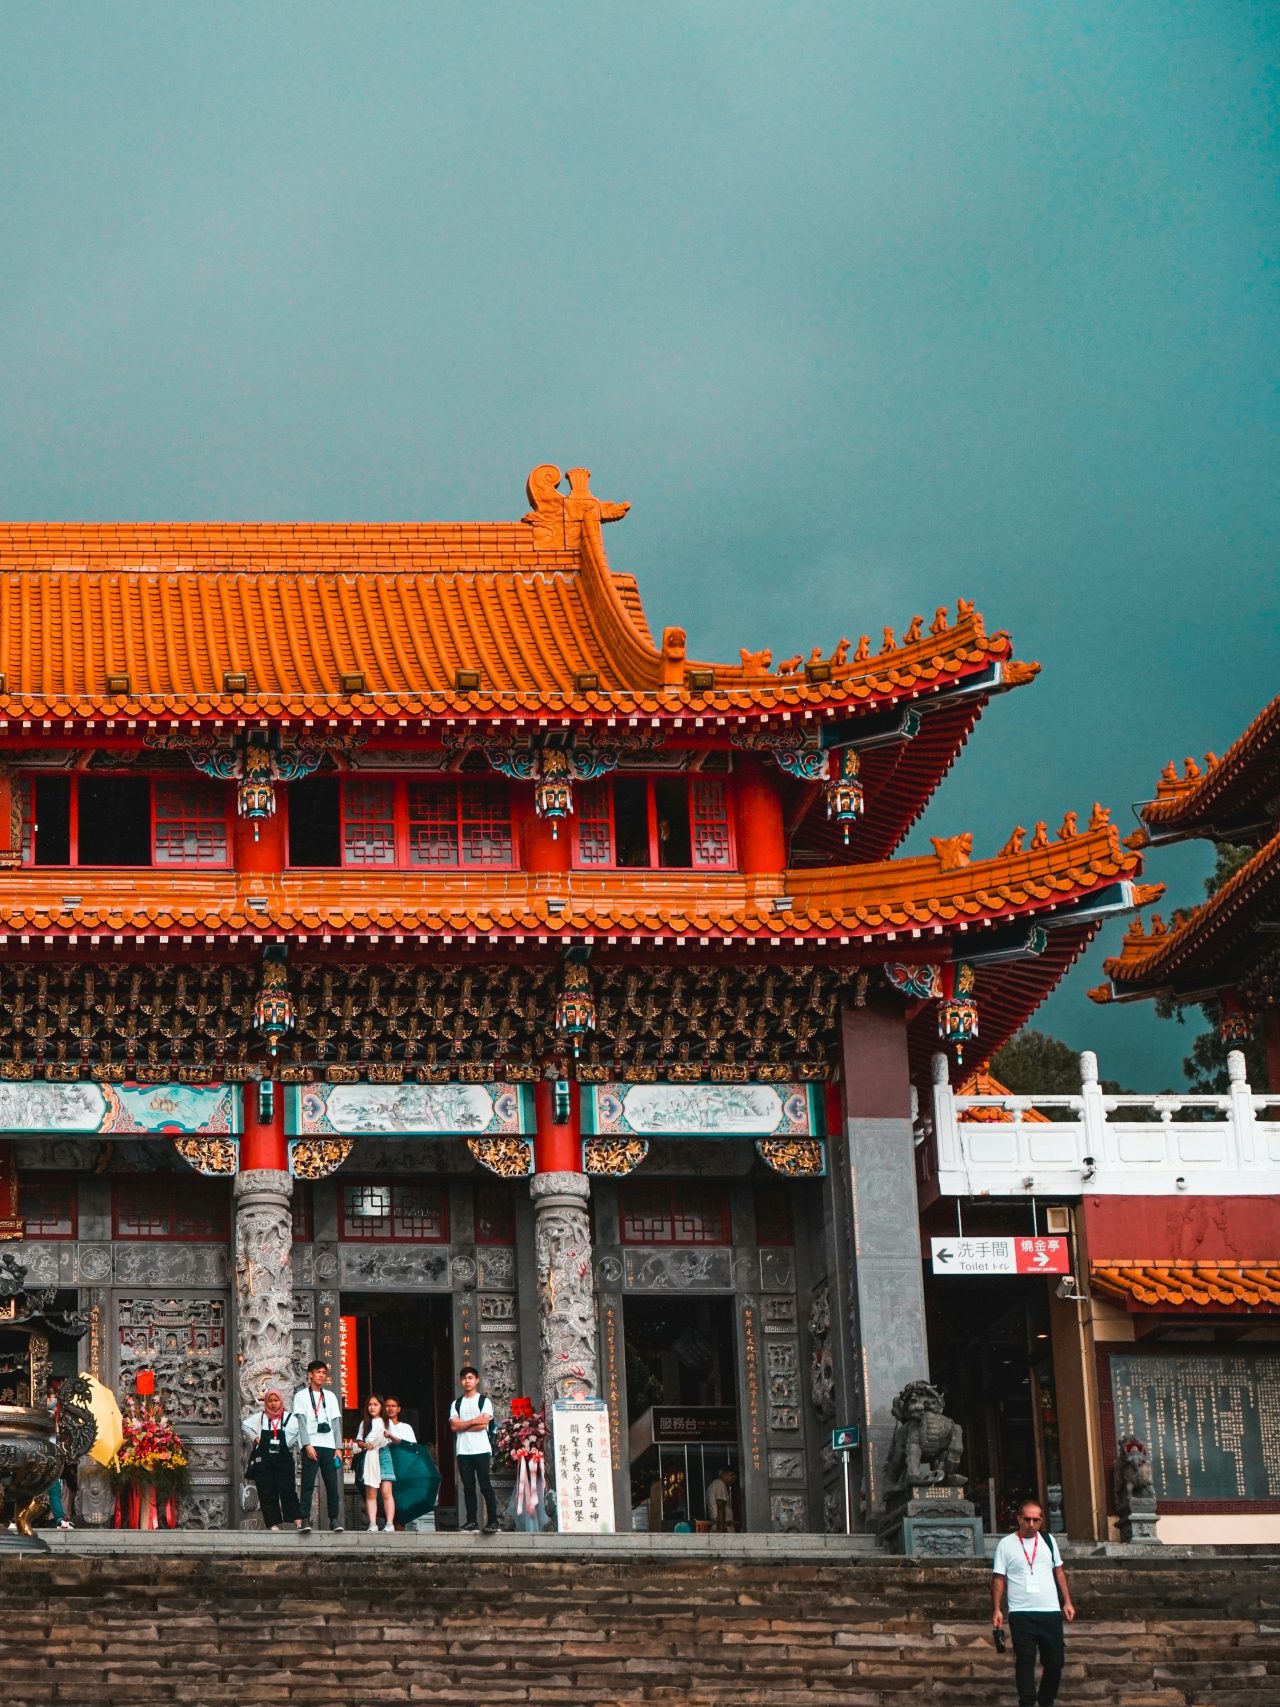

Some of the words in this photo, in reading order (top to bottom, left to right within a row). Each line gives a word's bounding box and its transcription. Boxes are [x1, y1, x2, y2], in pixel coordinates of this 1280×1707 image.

[957, 1241, 1009, 1258] 洗手間
[1021, 1240, 1060, 1252] 燒金亭
[959, 1262, 989, 1271] Toilet
[992, 1263, 1010, 1271] トイレ
[659, 1417, 697, 1430] 服務台
